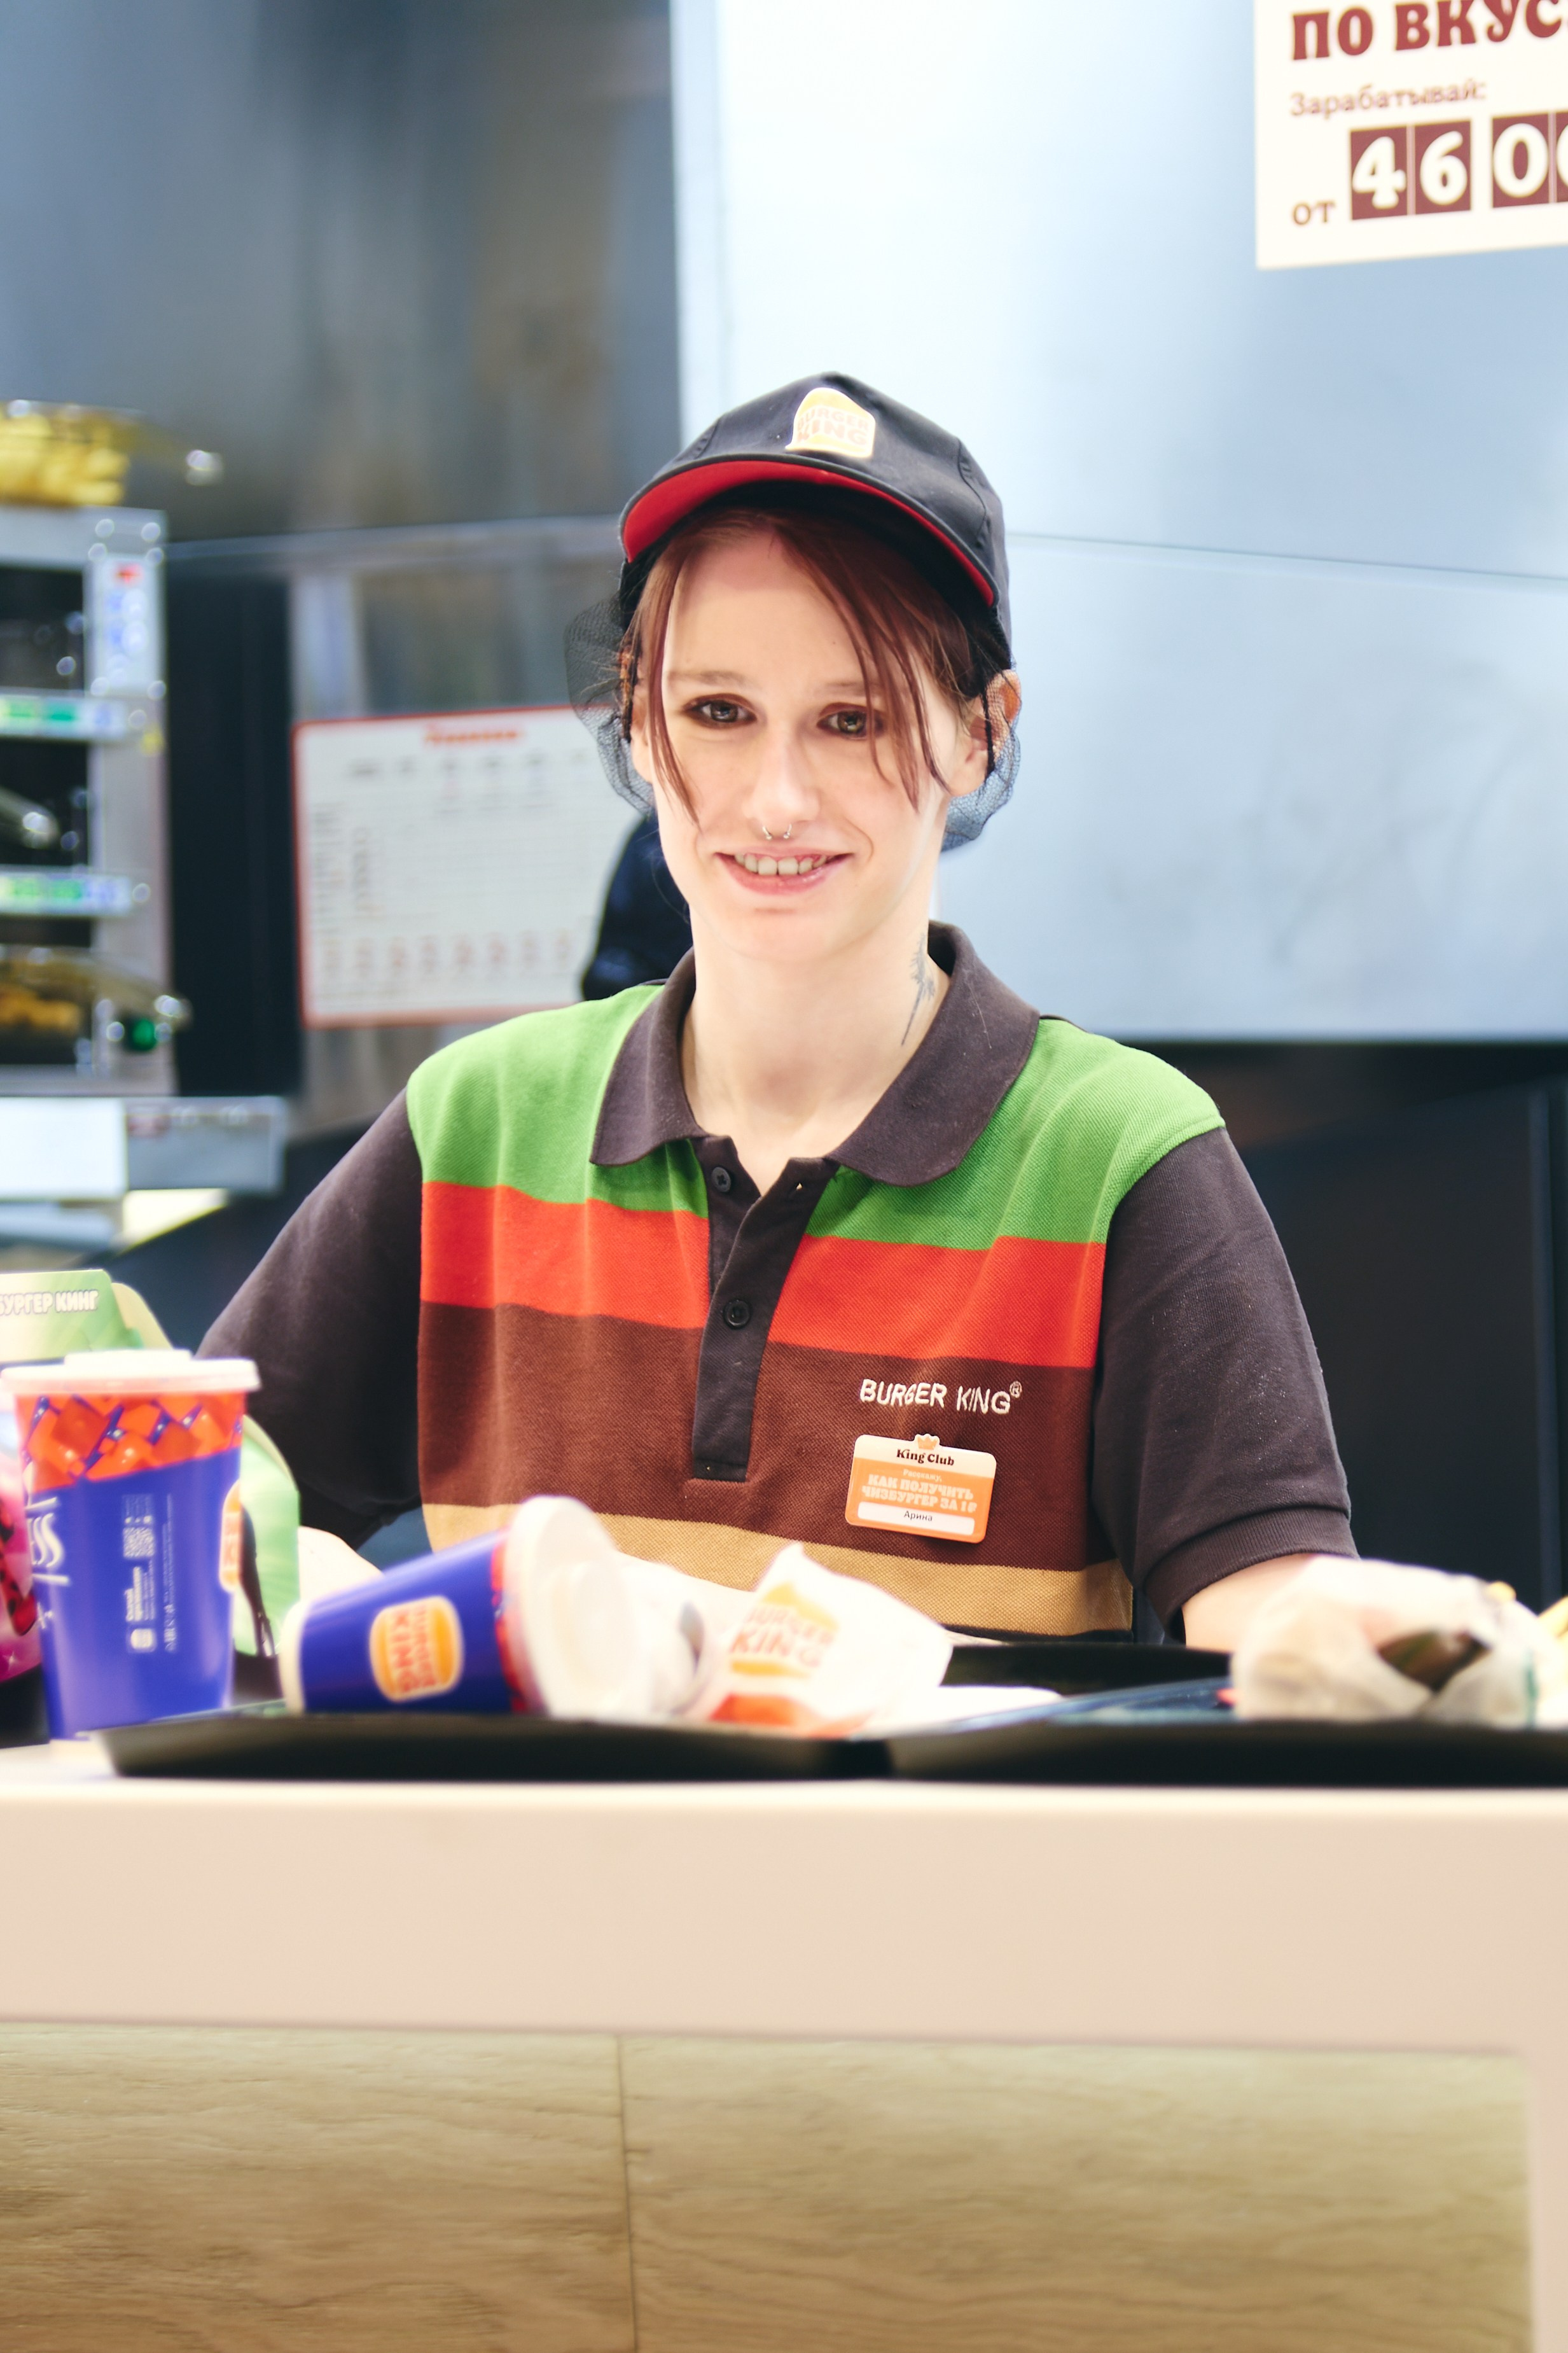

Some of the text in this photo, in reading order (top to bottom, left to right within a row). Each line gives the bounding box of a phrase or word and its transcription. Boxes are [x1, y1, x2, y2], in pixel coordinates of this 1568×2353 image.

[1395, 0, 1568, 50] ВКУС
[1291, 80, 1486, 118] Зарабатывай:
[55, 1289, 99, 1313] КИНГ
[859, 1378, 948, 1409] BURGER
[896, 1449, 955, 1466] King Club
[868, 1474, 975, 1500] КАК ПОЛУЧИТЬ
[903, 1469, 942, 1482] Расскажу,
[861, 1485, 938, 1507] ЧИЗБУРГЕР
[940, 1498, 959, 1511] ЗА
[903, 1511, 933, 1522] Арина
